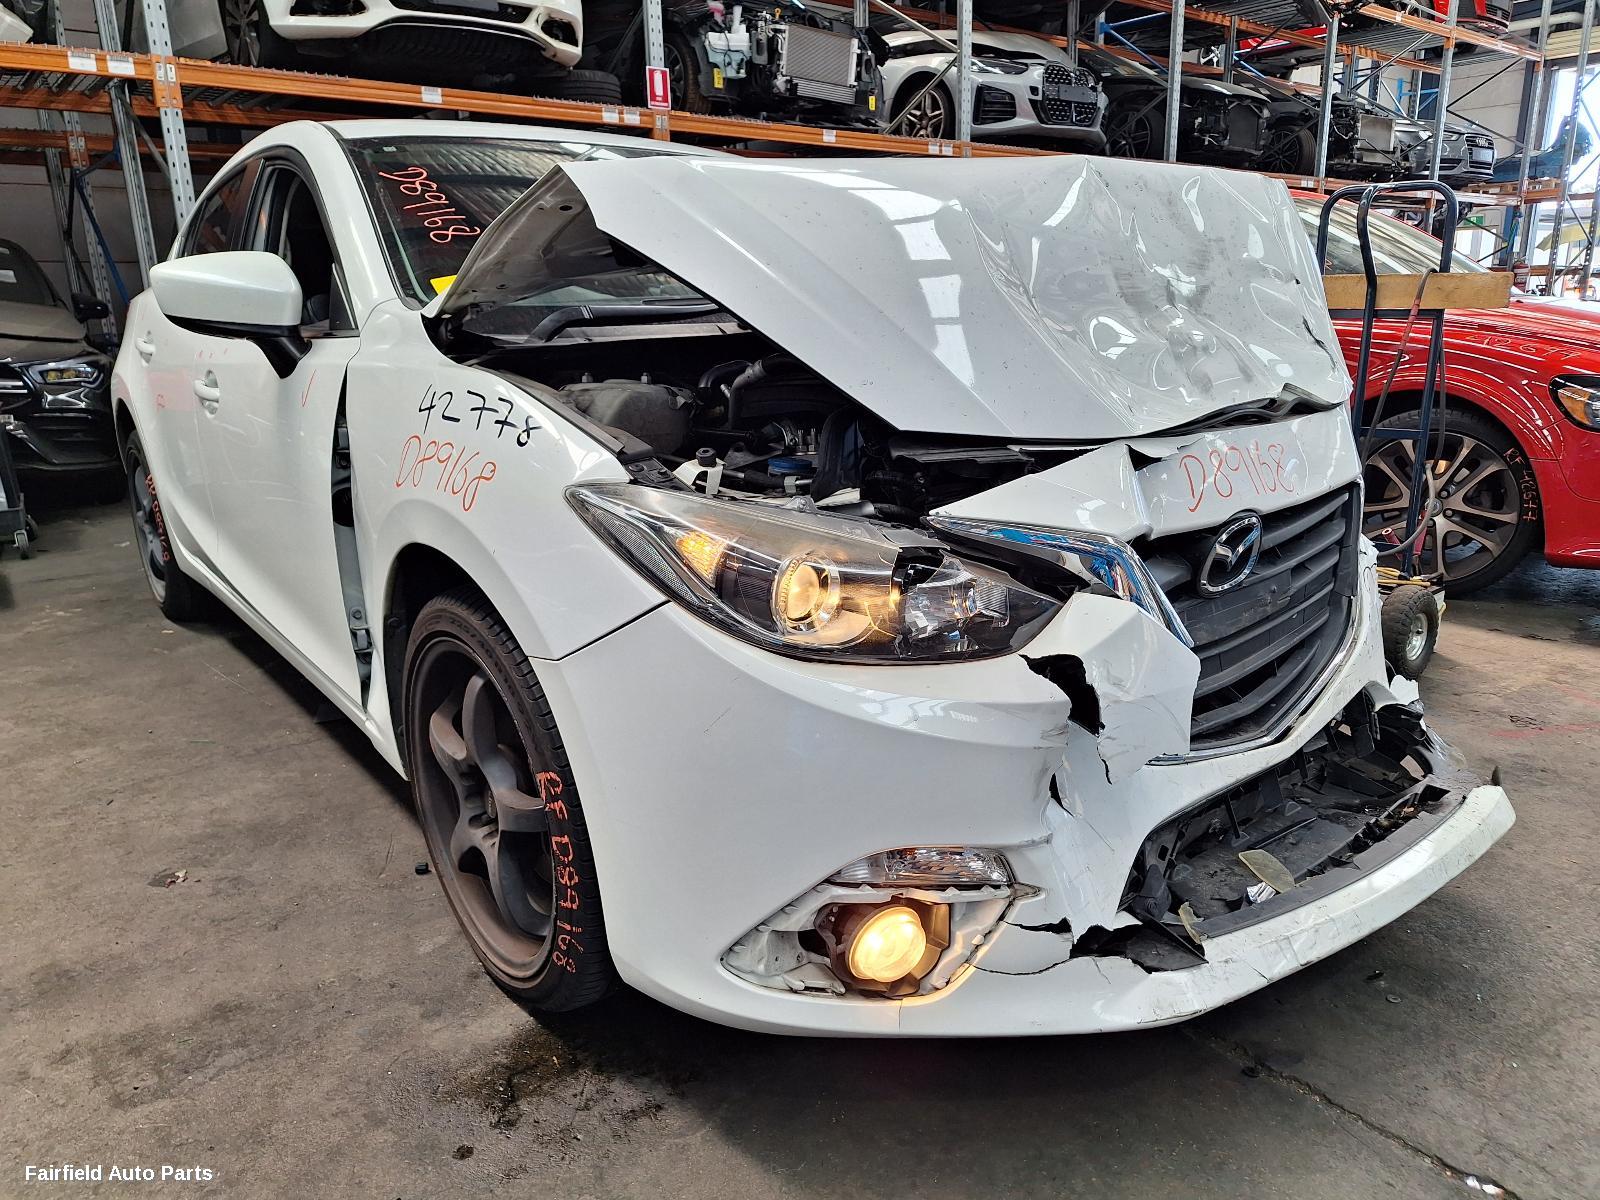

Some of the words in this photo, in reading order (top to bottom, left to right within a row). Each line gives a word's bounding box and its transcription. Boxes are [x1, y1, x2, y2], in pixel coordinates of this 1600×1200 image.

[378, 166, 481, 243] D89168
[418, 383, 543, 447] 42778
[396, 434, 497, 512] D89168
[1178, 439, 1295, 513] D89168
[551, 834, 584, 974] D89168
